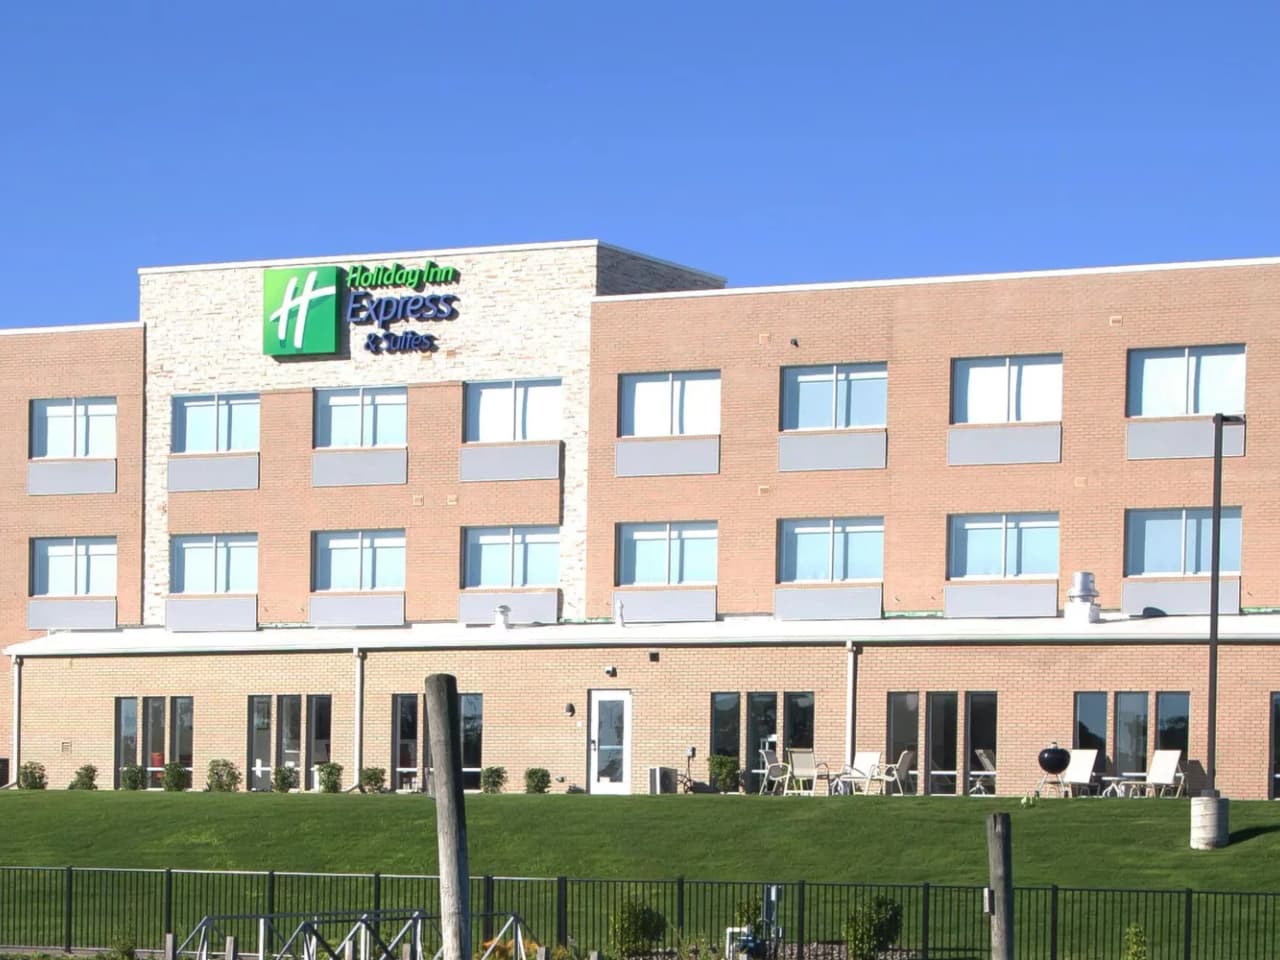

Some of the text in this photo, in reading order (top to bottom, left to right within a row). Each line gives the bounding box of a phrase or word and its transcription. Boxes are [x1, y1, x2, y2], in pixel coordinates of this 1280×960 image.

[346, 260, 454, 289] Holiday Inn
[346, 290, 453, 329] Express
[366, 332, 432, 352] & Suites
